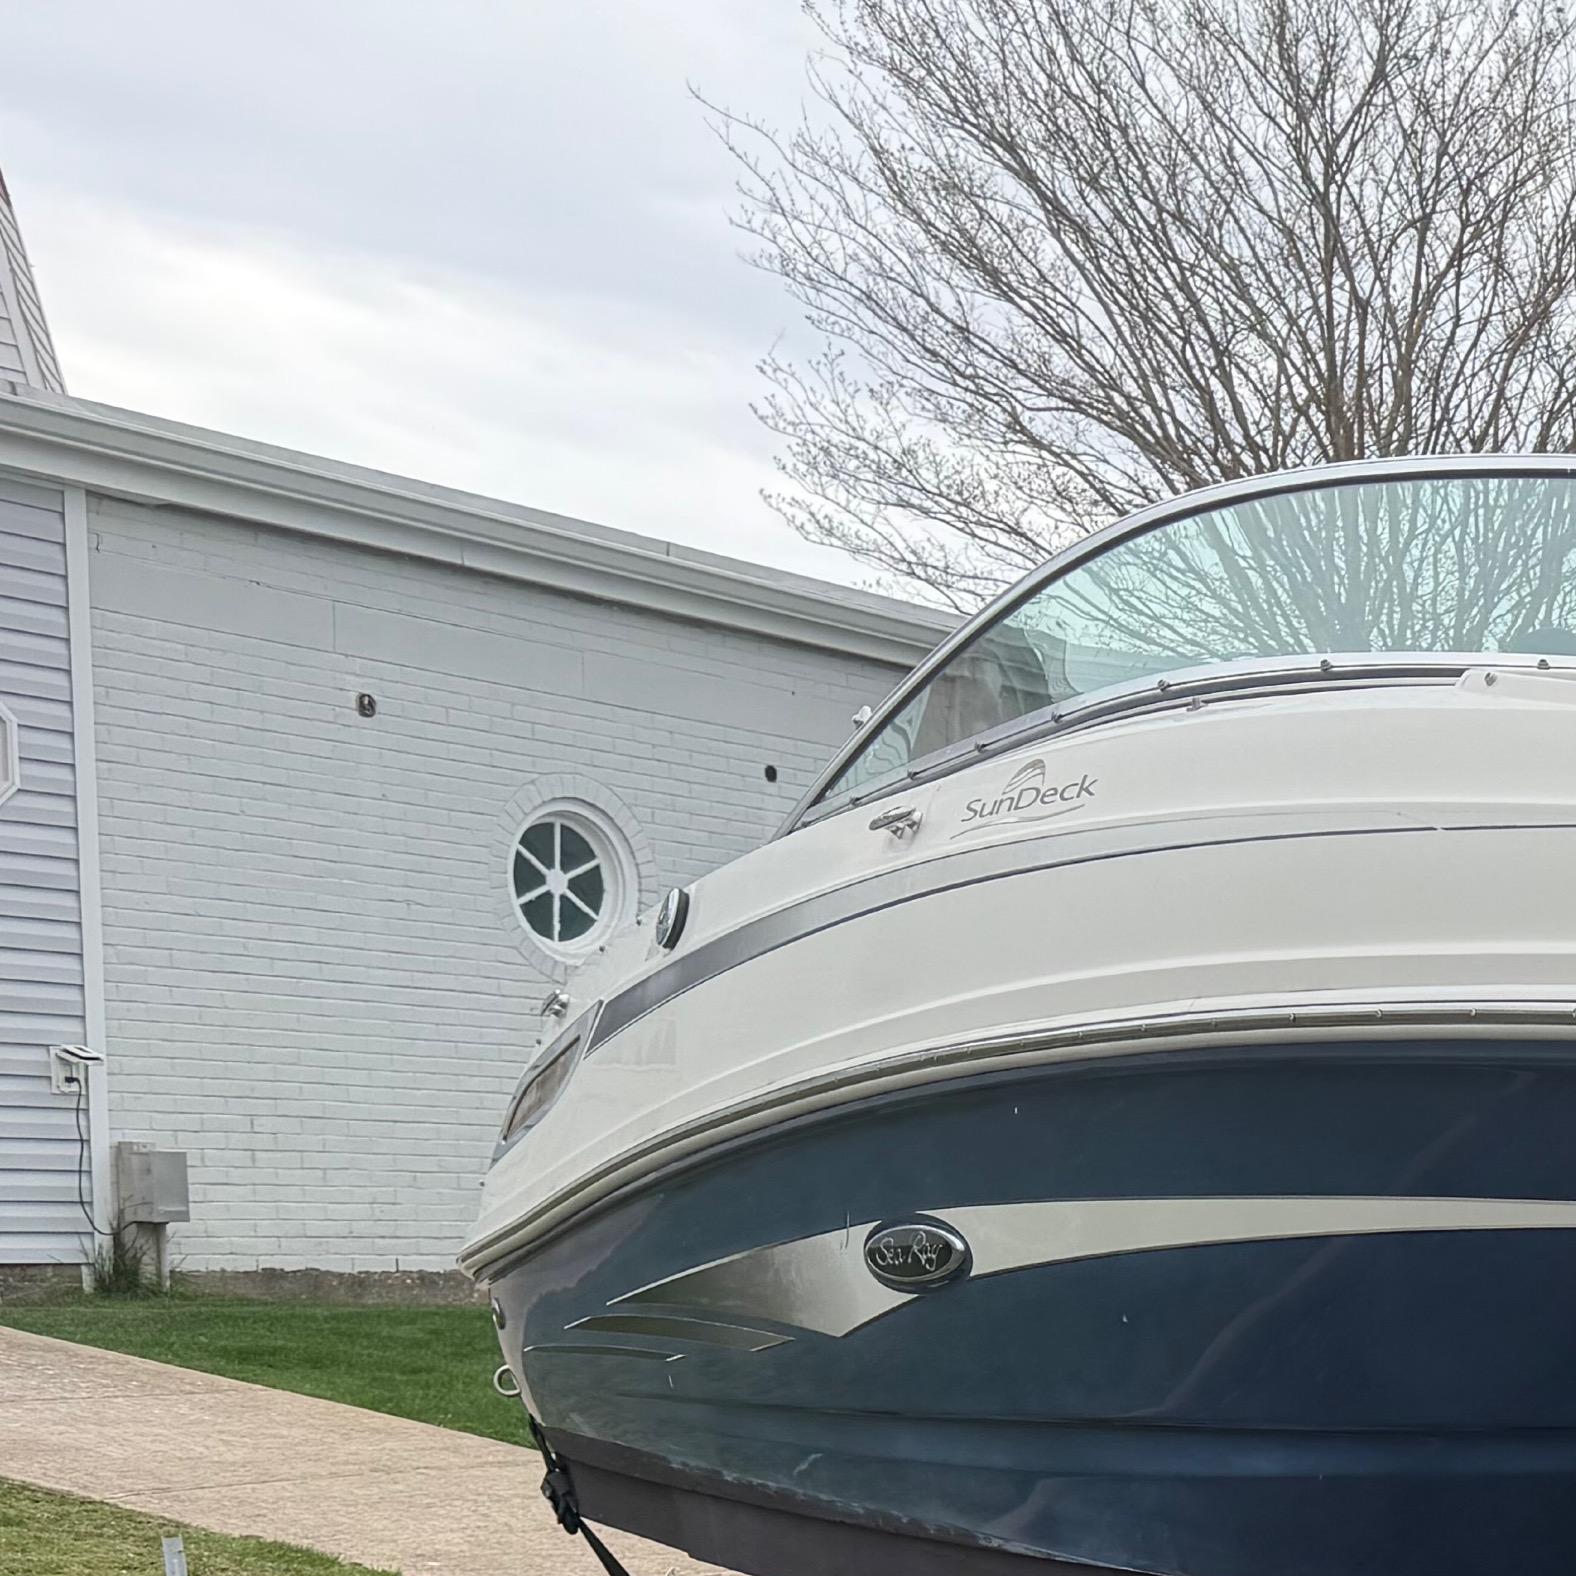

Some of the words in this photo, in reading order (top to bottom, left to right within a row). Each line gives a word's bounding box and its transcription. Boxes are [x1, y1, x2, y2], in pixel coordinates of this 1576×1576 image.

[961, 774, 1098, 822] SunDeck
[875, 1237, 904, 1266] Sea
[908, 1231, 943, 1271] Ray
